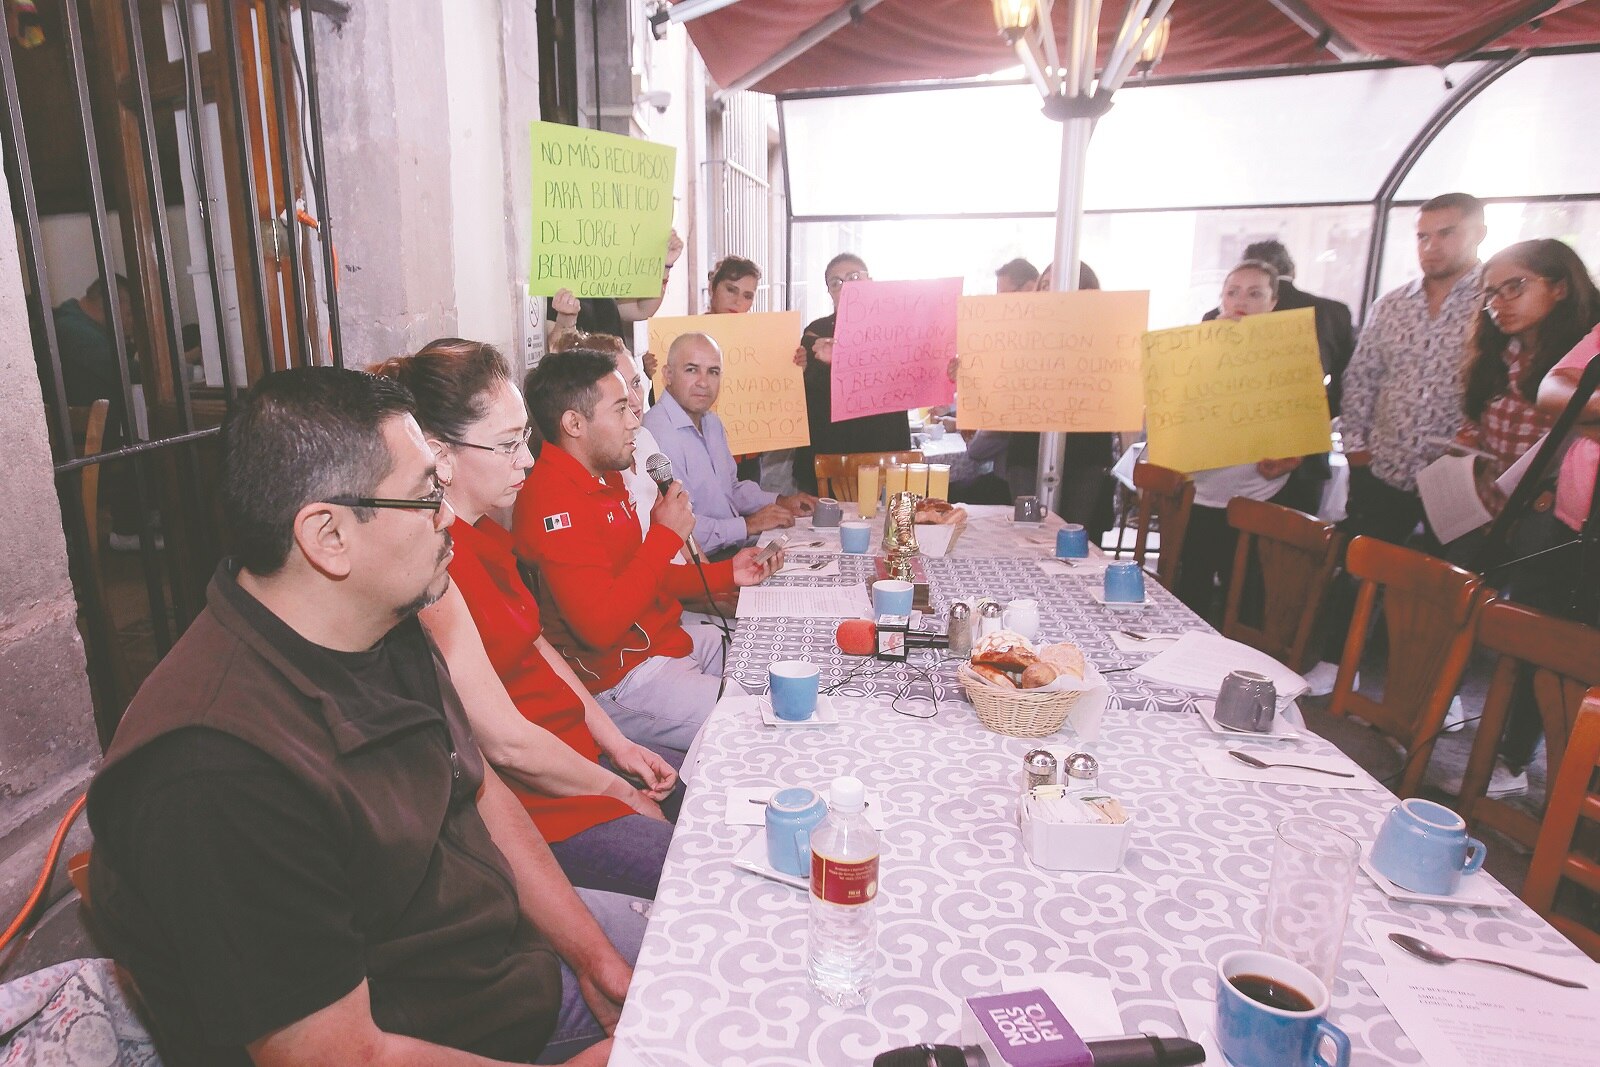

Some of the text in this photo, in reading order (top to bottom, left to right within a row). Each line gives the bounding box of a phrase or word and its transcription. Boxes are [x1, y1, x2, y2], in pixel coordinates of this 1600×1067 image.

[541, 136, 669, 183] NO MÁS RECURSOS
[544, 180, 659, 211] PARA BENEFICIO
[541, 218, 640, 248] DE JORGE Y
[538, 252, 662, 280] BERNARDO OLVERA
[580, 277, 632, 297] GONZÁLEZ
[962, 302, 985, 320] NO
[960, 353, 984, 371] LA
[1000, 356, 1066, 372] LUCHA
[1170, 355, 1202, 378] LA
[836, 377, 847, 397] Y
[959, 375, 982, 390] DE
[962, 395, 990, 411] EN
[1147, 387, 1172, 405] DE
[988, 1008, 1027, 1047] NOTI
[1005, 1006, 1042, 1044] CIAS
[1025, 1003, 1064, 1041] RTQ
